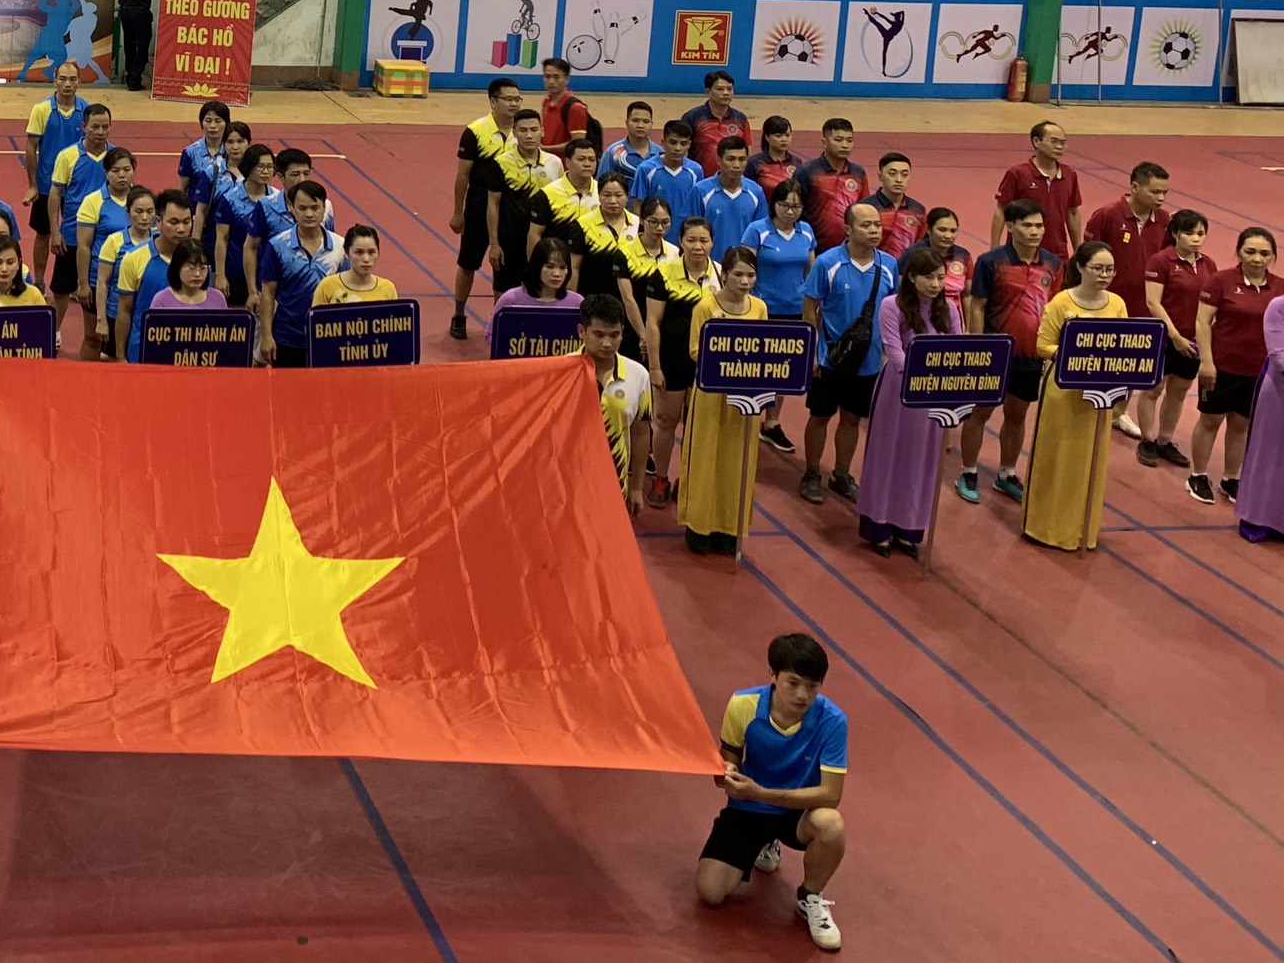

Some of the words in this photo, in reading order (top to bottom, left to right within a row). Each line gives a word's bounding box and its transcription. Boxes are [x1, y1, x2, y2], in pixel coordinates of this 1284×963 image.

[176, 23, 208, 45] BÁC
[212, 23, 235, 48] HỒ
[175, 52, 190, 73] VĨ
[193, 55, 221, 78] ĐẠI
[680, 51, 701, 59] KIM
[702, 50, 720, 60] TÍN
[1, 320, 18, 339] ÁN
[147, 326, 171, 346] CỤC
[174, 327, 192, 342] THI
[195, 324, 227, 342] HÀNH
[229, 324, 246, 342] ÁN
[316, 322, 342, 339] BAN
[346, 317, 369, 338] NỘI
[372, 314, 412, 335] CHÍNH
[338, 341, 369, 362] TỈNH
[372, 338, 389, 359] ỦY
[509, 332, 527, 356] SỞ
[529, 334, 549, 356] TÀI
[709, 336, 730, 352] CHI
[734, 337, 761, 356] CỤC
[763, 338, 805, 355] THADS
[1076, 333, 1094, 348] CHI
[1095, 333, 1117, 352] CỤC
[1119, 333, 1153, 349] THADS
[174, 348, 198, 367] DÂN
[925, 351, 942, 367] CHI
[943, 351, 962, 370] CỤC
[963, 351, 993, 367] THADS
[1067, 354, 1101, 375] HUYỆN
[1103, 356, 1136, 375] THẠCH
[1137, 358, 1154, 373] AN
[719, 358, 761, 379] THÀNH
[764, 358, 792, 380] PHỐ
[909, 373, 940, 394] HUYỆN
[940, 372, 977, 391] NGUYÊN
[977, 372, 1001, 390] BÌNH
